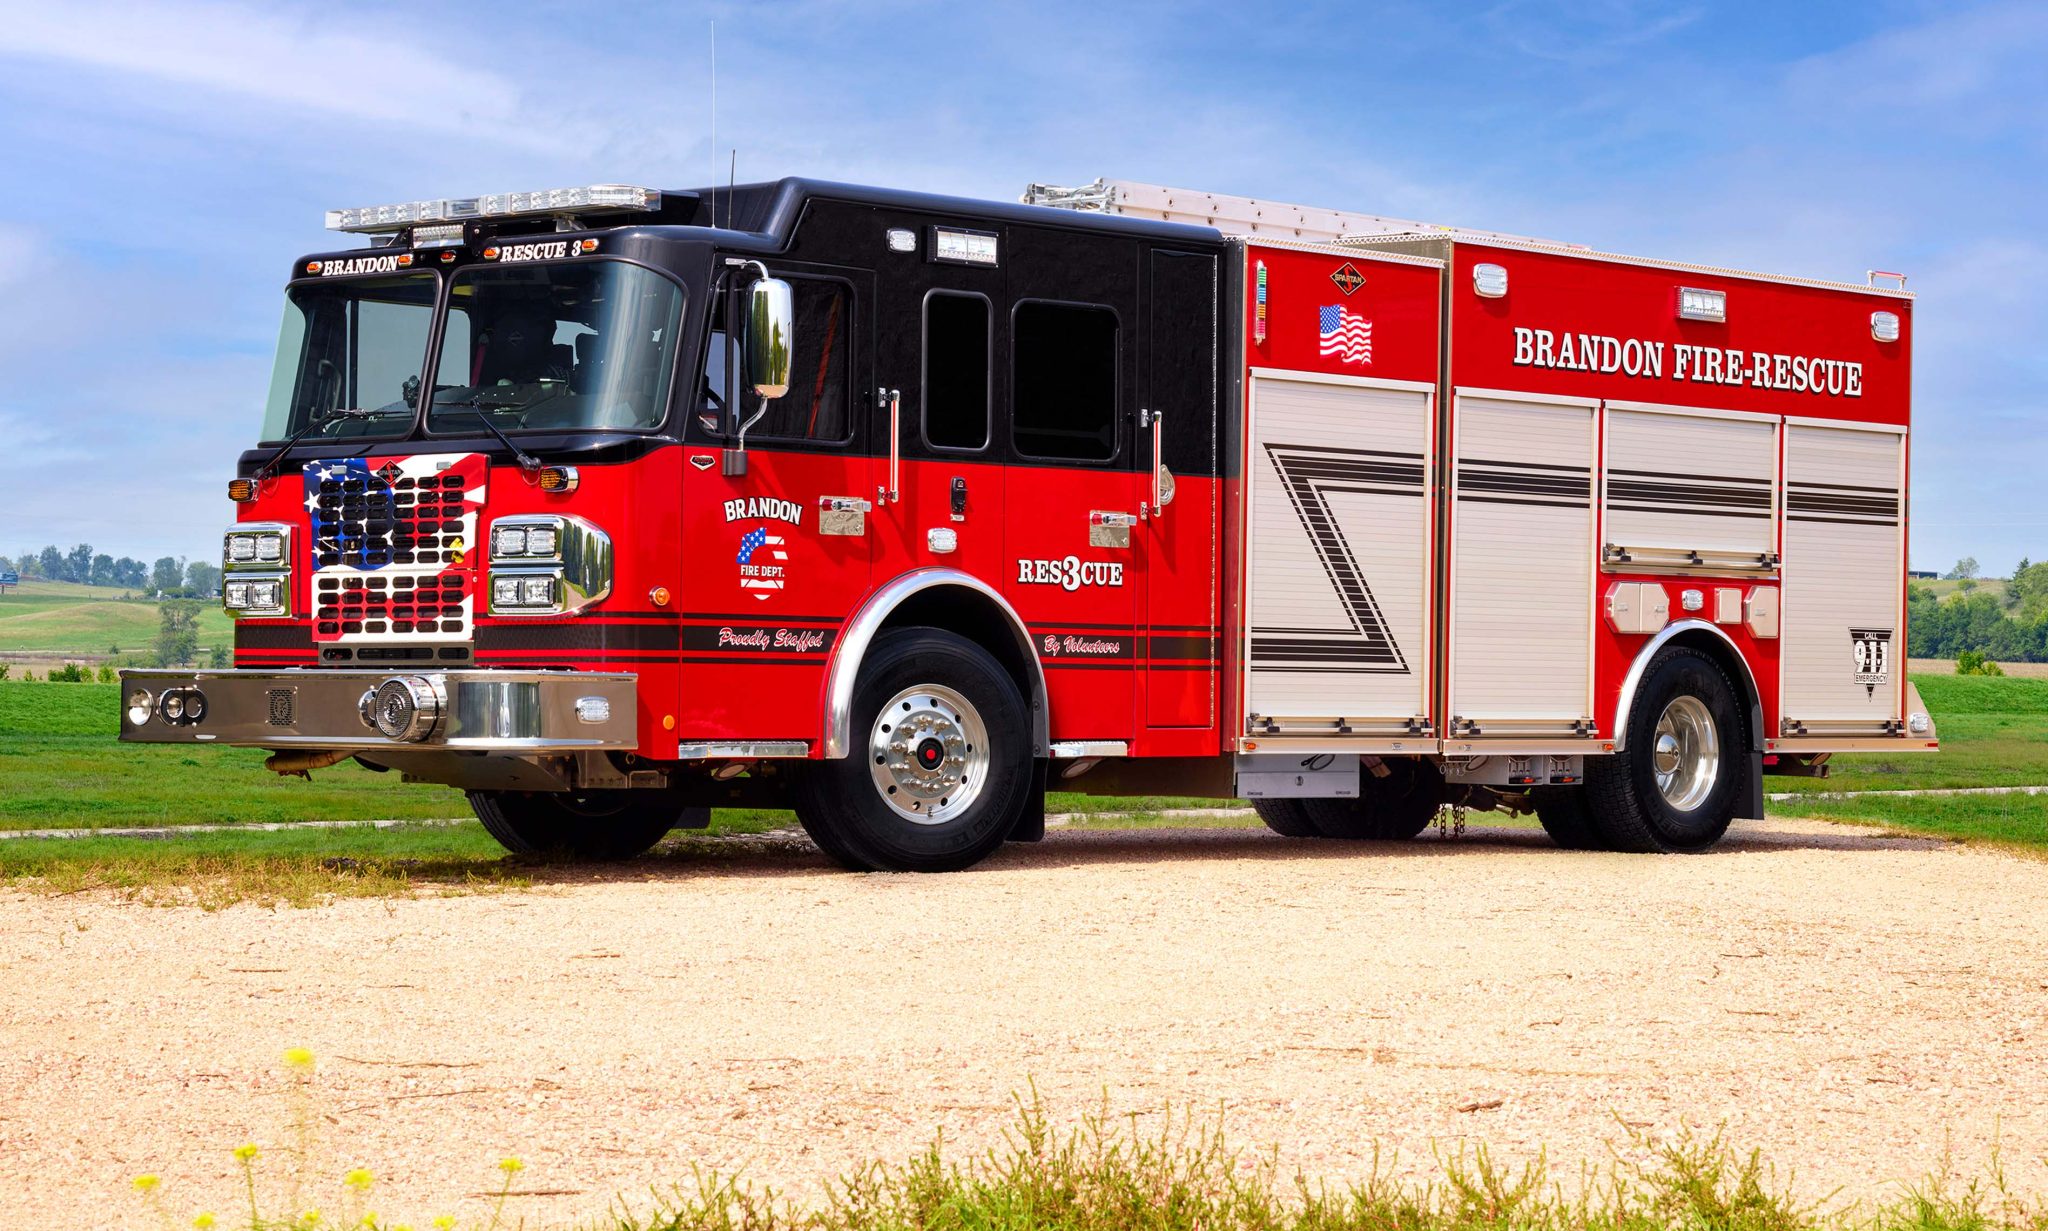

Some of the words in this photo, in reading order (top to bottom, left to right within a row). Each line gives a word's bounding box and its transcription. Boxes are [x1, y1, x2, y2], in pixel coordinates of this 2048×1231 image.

[500, 242, 567, 262] RESCUE
[571, 240, 582, 257] 3
[322, 255, 400, 276] BRANDON
[1513, 327, 1665, 377] BRANDON
[1673, 343, 1863, 397] FIRE-RESCUE
[723, 497, 803, 525] BRANDON
[740, 565, 759, 576] FIRE
[761, 566, 785, 578] DEPT.
[719, 627, 770, 651] Proudly
[773, 628, 824, 652] Staffed
[1044, 635, 1060, 656] By
[1063, 635, 1120, 654] Volunteers
[1864, 632, 1878, 640] CALL
[1855, 674, 1887, 682] EMERGENCY
